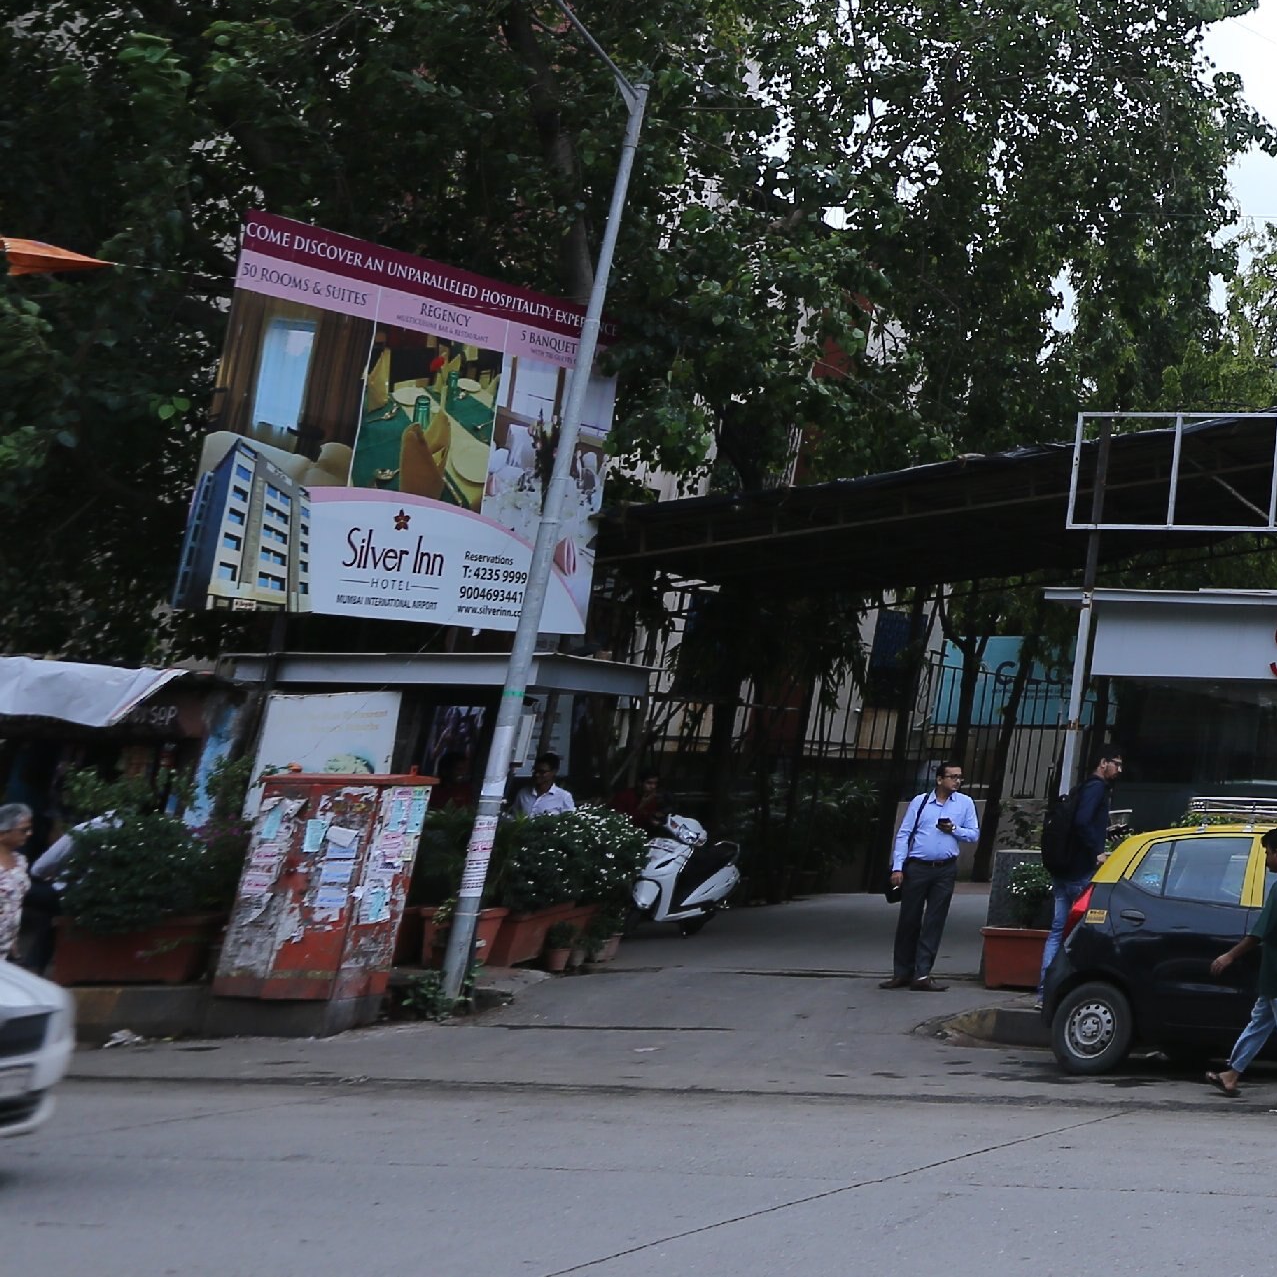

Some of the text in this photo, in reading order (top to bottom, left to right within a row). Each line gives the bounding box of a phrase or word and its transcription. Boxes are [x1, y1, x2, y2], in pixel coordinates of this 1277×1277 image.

[246, 222, 291, 248] COME
[293, 235, 363, 268] DISCOVER
[363, 255, 385, 274] AN
[387, 261, 478, 299] UNPARALLELED
[480, 288, 554, 320] HOSPITALITY
[242, 262, 368, 306] 50 ROOMS & SUITES
[420, 302, 472, 327] REGENCY
[520, 330, 578, 354] 5 BANQUET
[341, 527, 445, 577] Silver Inn
[464, 550, 515, 567] Reservations
[370, 578, 412, 592] HOTEL
[462, 565, 528, 585] T: 4235 9999
[336, 594, 438, 611] MUMBAI INTERNATIONAL AIRPORT
[459, 586, 524, 604] 9004693441
